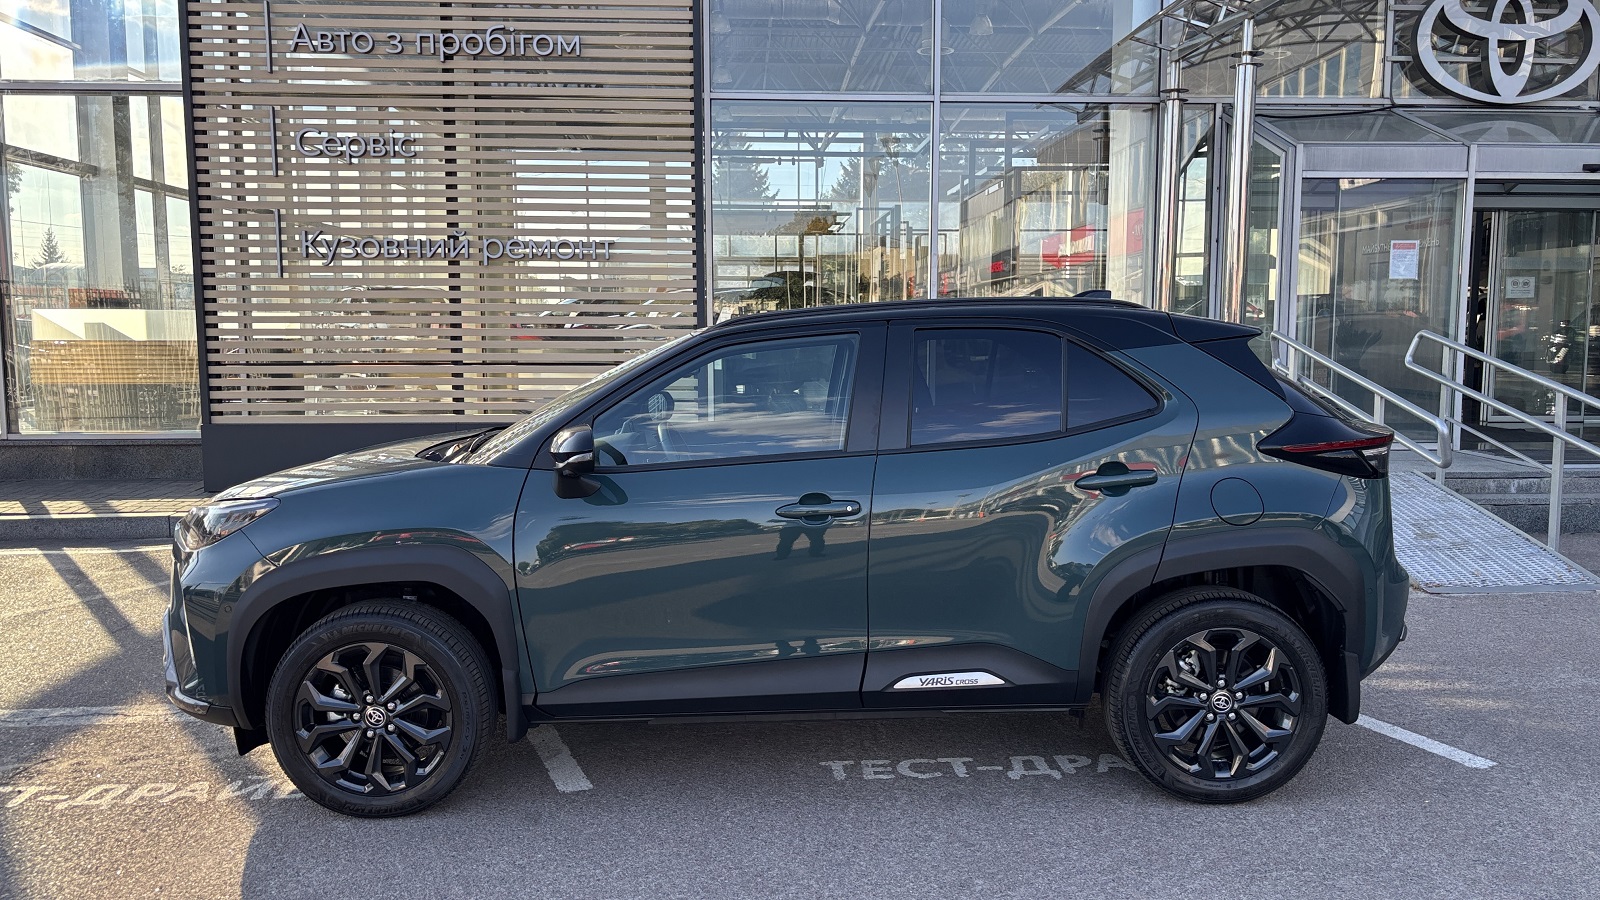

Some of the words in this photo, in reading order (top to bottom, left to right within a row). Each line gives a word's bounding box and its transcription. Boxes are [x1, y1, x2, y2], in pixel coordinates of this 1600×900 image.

[290, 22, 375, 54] Авто
[385, 31, 404, 55] з
[416, 24, 582, 63] пробігом
[295, 127, 417, 165] Сервіс
[300, 229, 471, 267] Кузовний
[482, 237, 616, 267] ремонт
[819, 753, 1136, 781] ТЕСТ-ДРА
